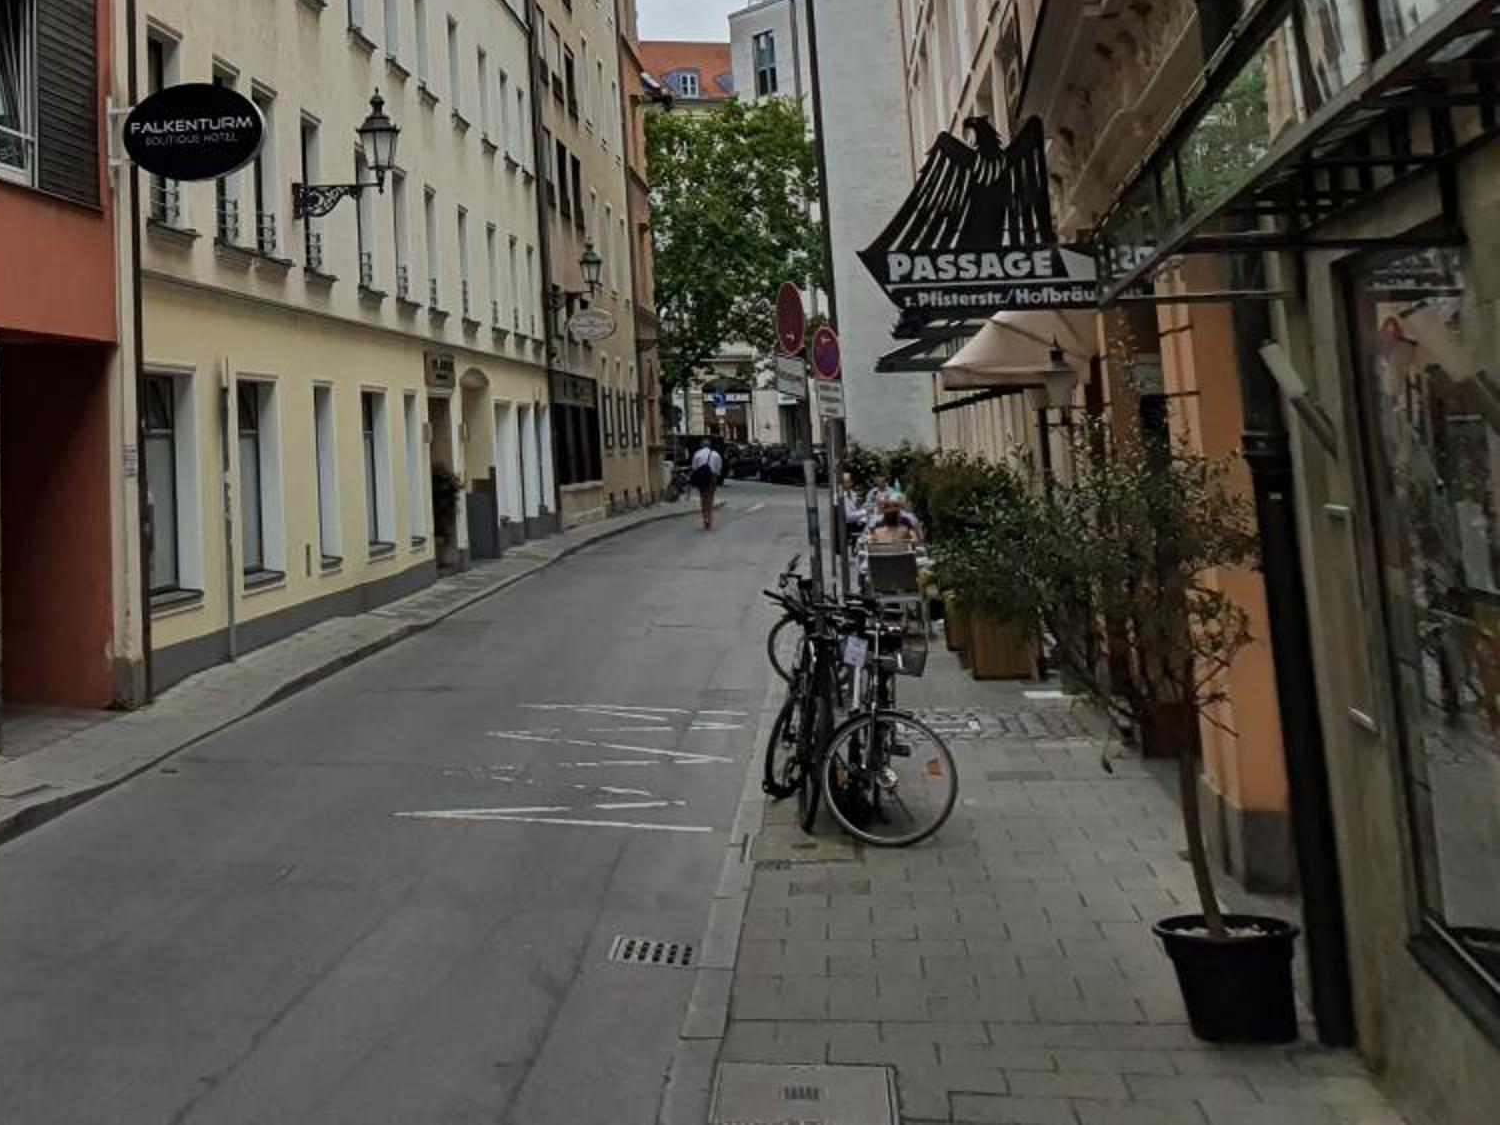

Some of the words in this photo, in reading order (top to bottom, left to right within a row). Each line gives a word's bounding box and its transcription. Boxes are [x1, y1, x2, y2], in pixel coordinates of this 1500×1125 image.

[130, 115, 254, 135] FALKENTURM
[145, 133, 201, 147] BOUTIQUE
[203, 130, 239, 142] HOTEL
[887, 251, 1053, 282] PASSAGE
